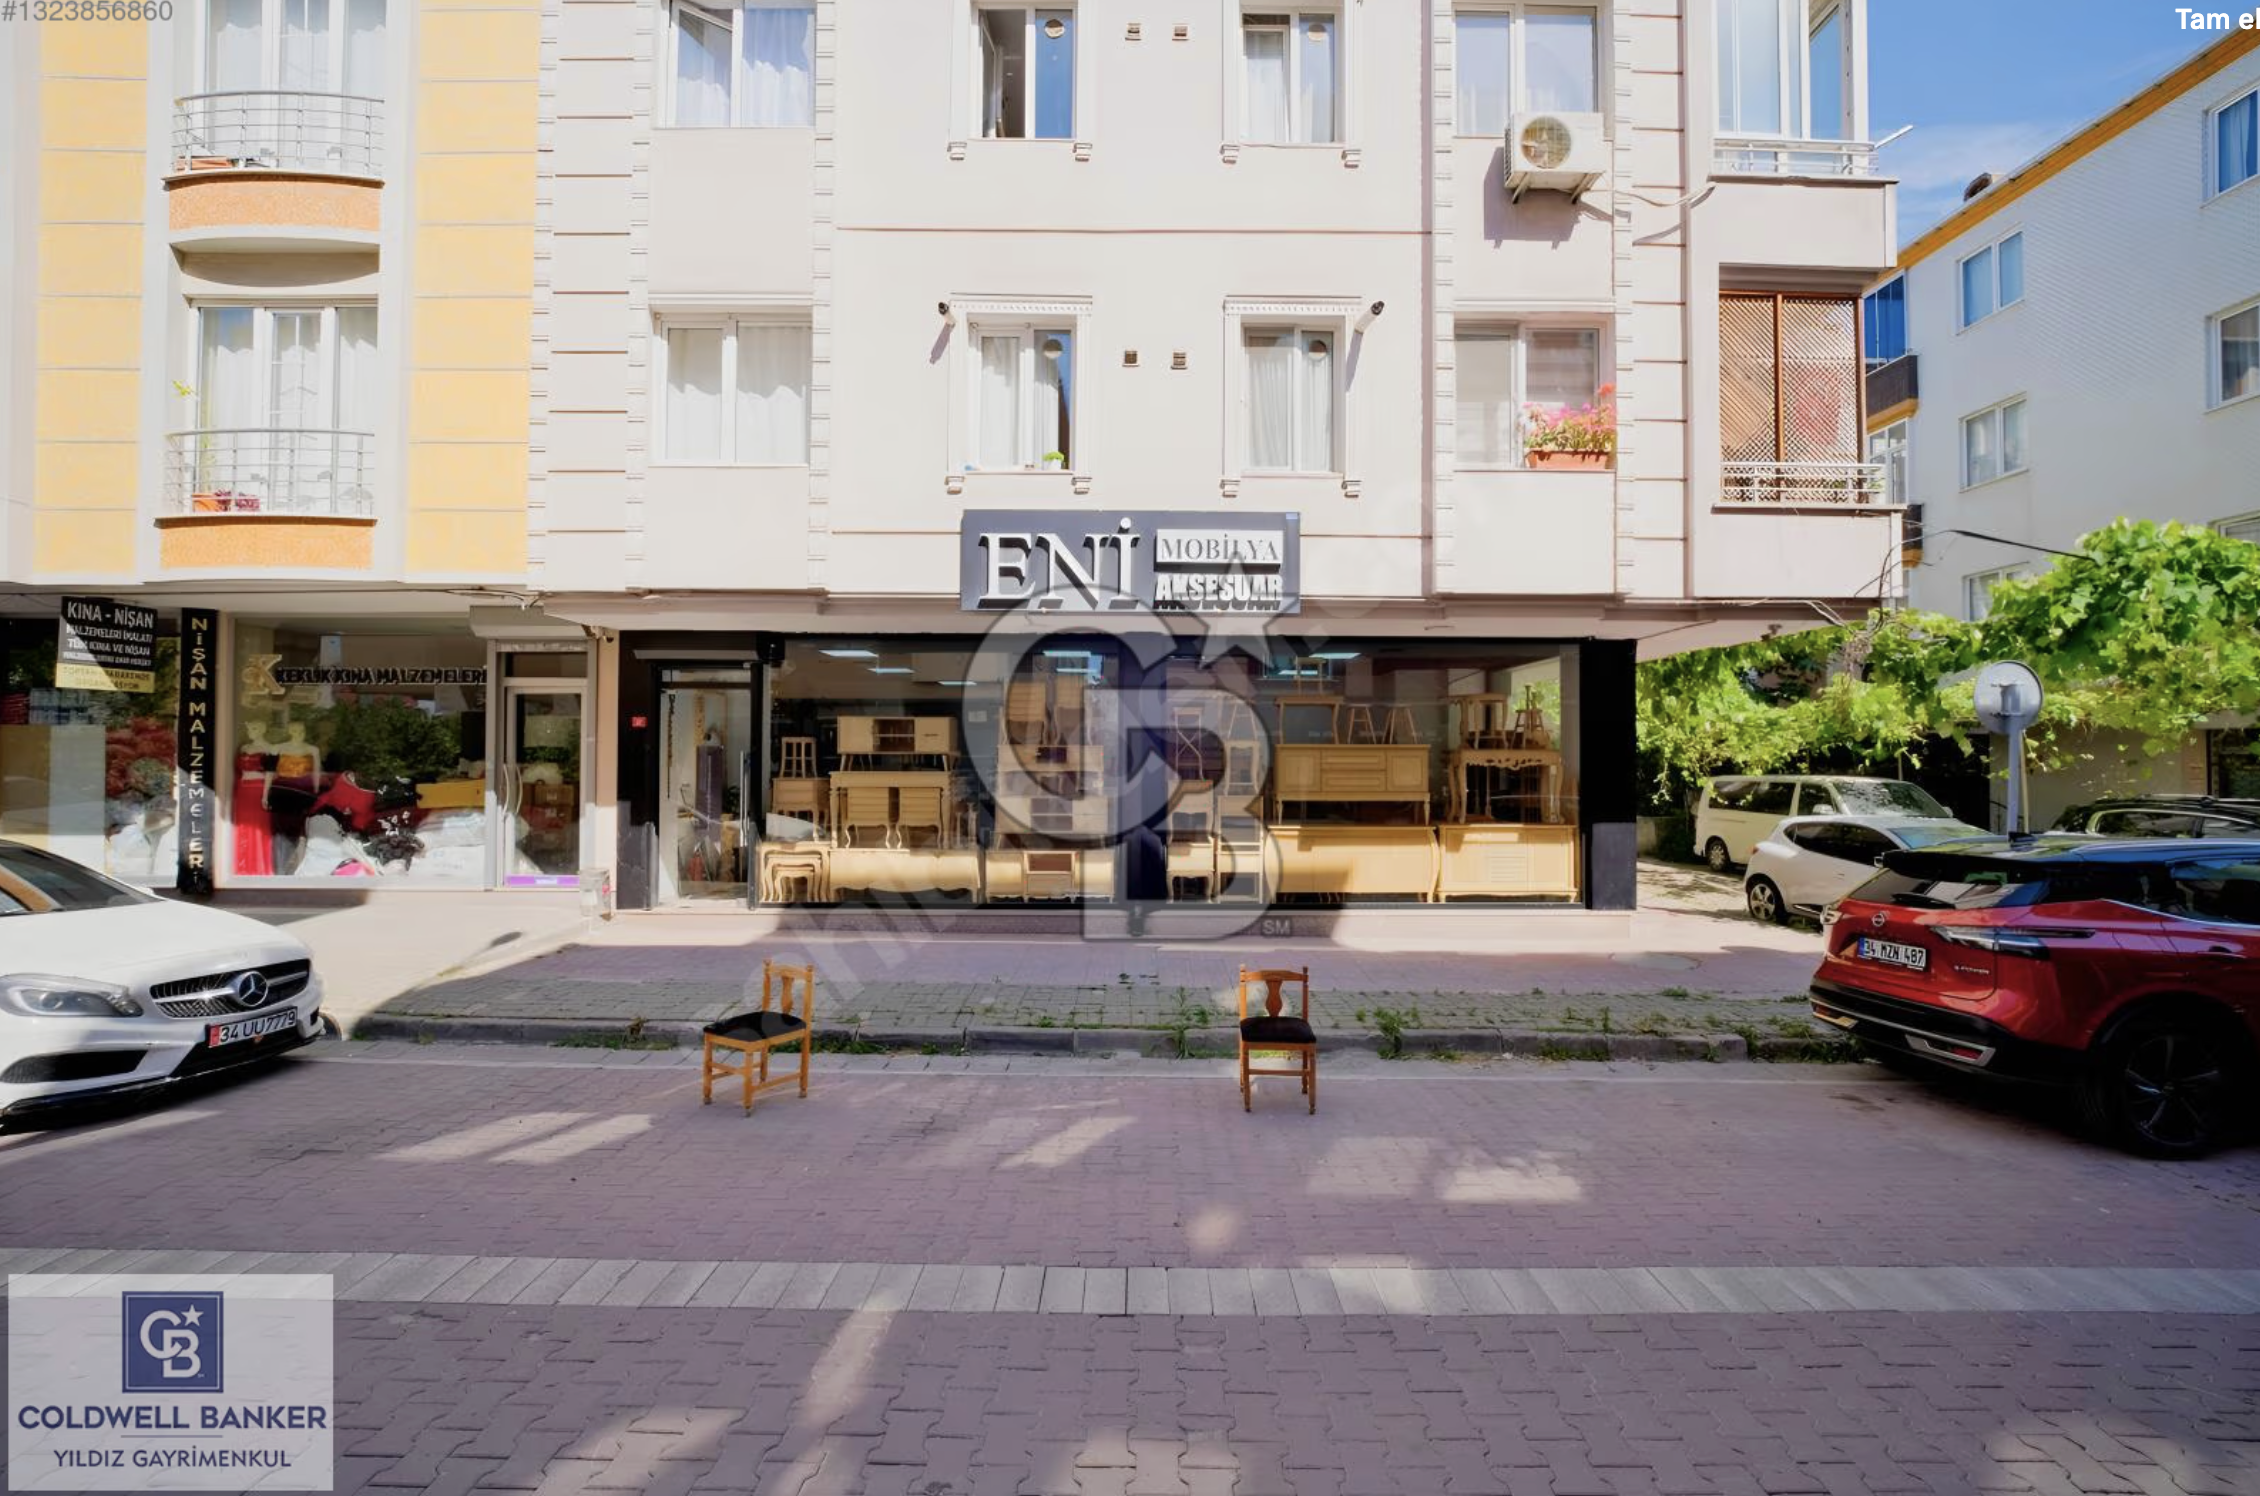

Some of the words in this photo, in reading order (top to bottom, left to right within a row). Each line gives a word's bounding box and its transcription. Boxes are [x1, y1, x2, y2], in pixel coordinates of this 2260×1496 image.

[1161, 533, 1279, 560] MOBİLYA
[1154, 573, 1283, 605] AKSESUAR
[67, 601, 102, 622] KINA
[114, 607, 154, 629] NİŞAN
[221, 1024, 239, 1043] 34
